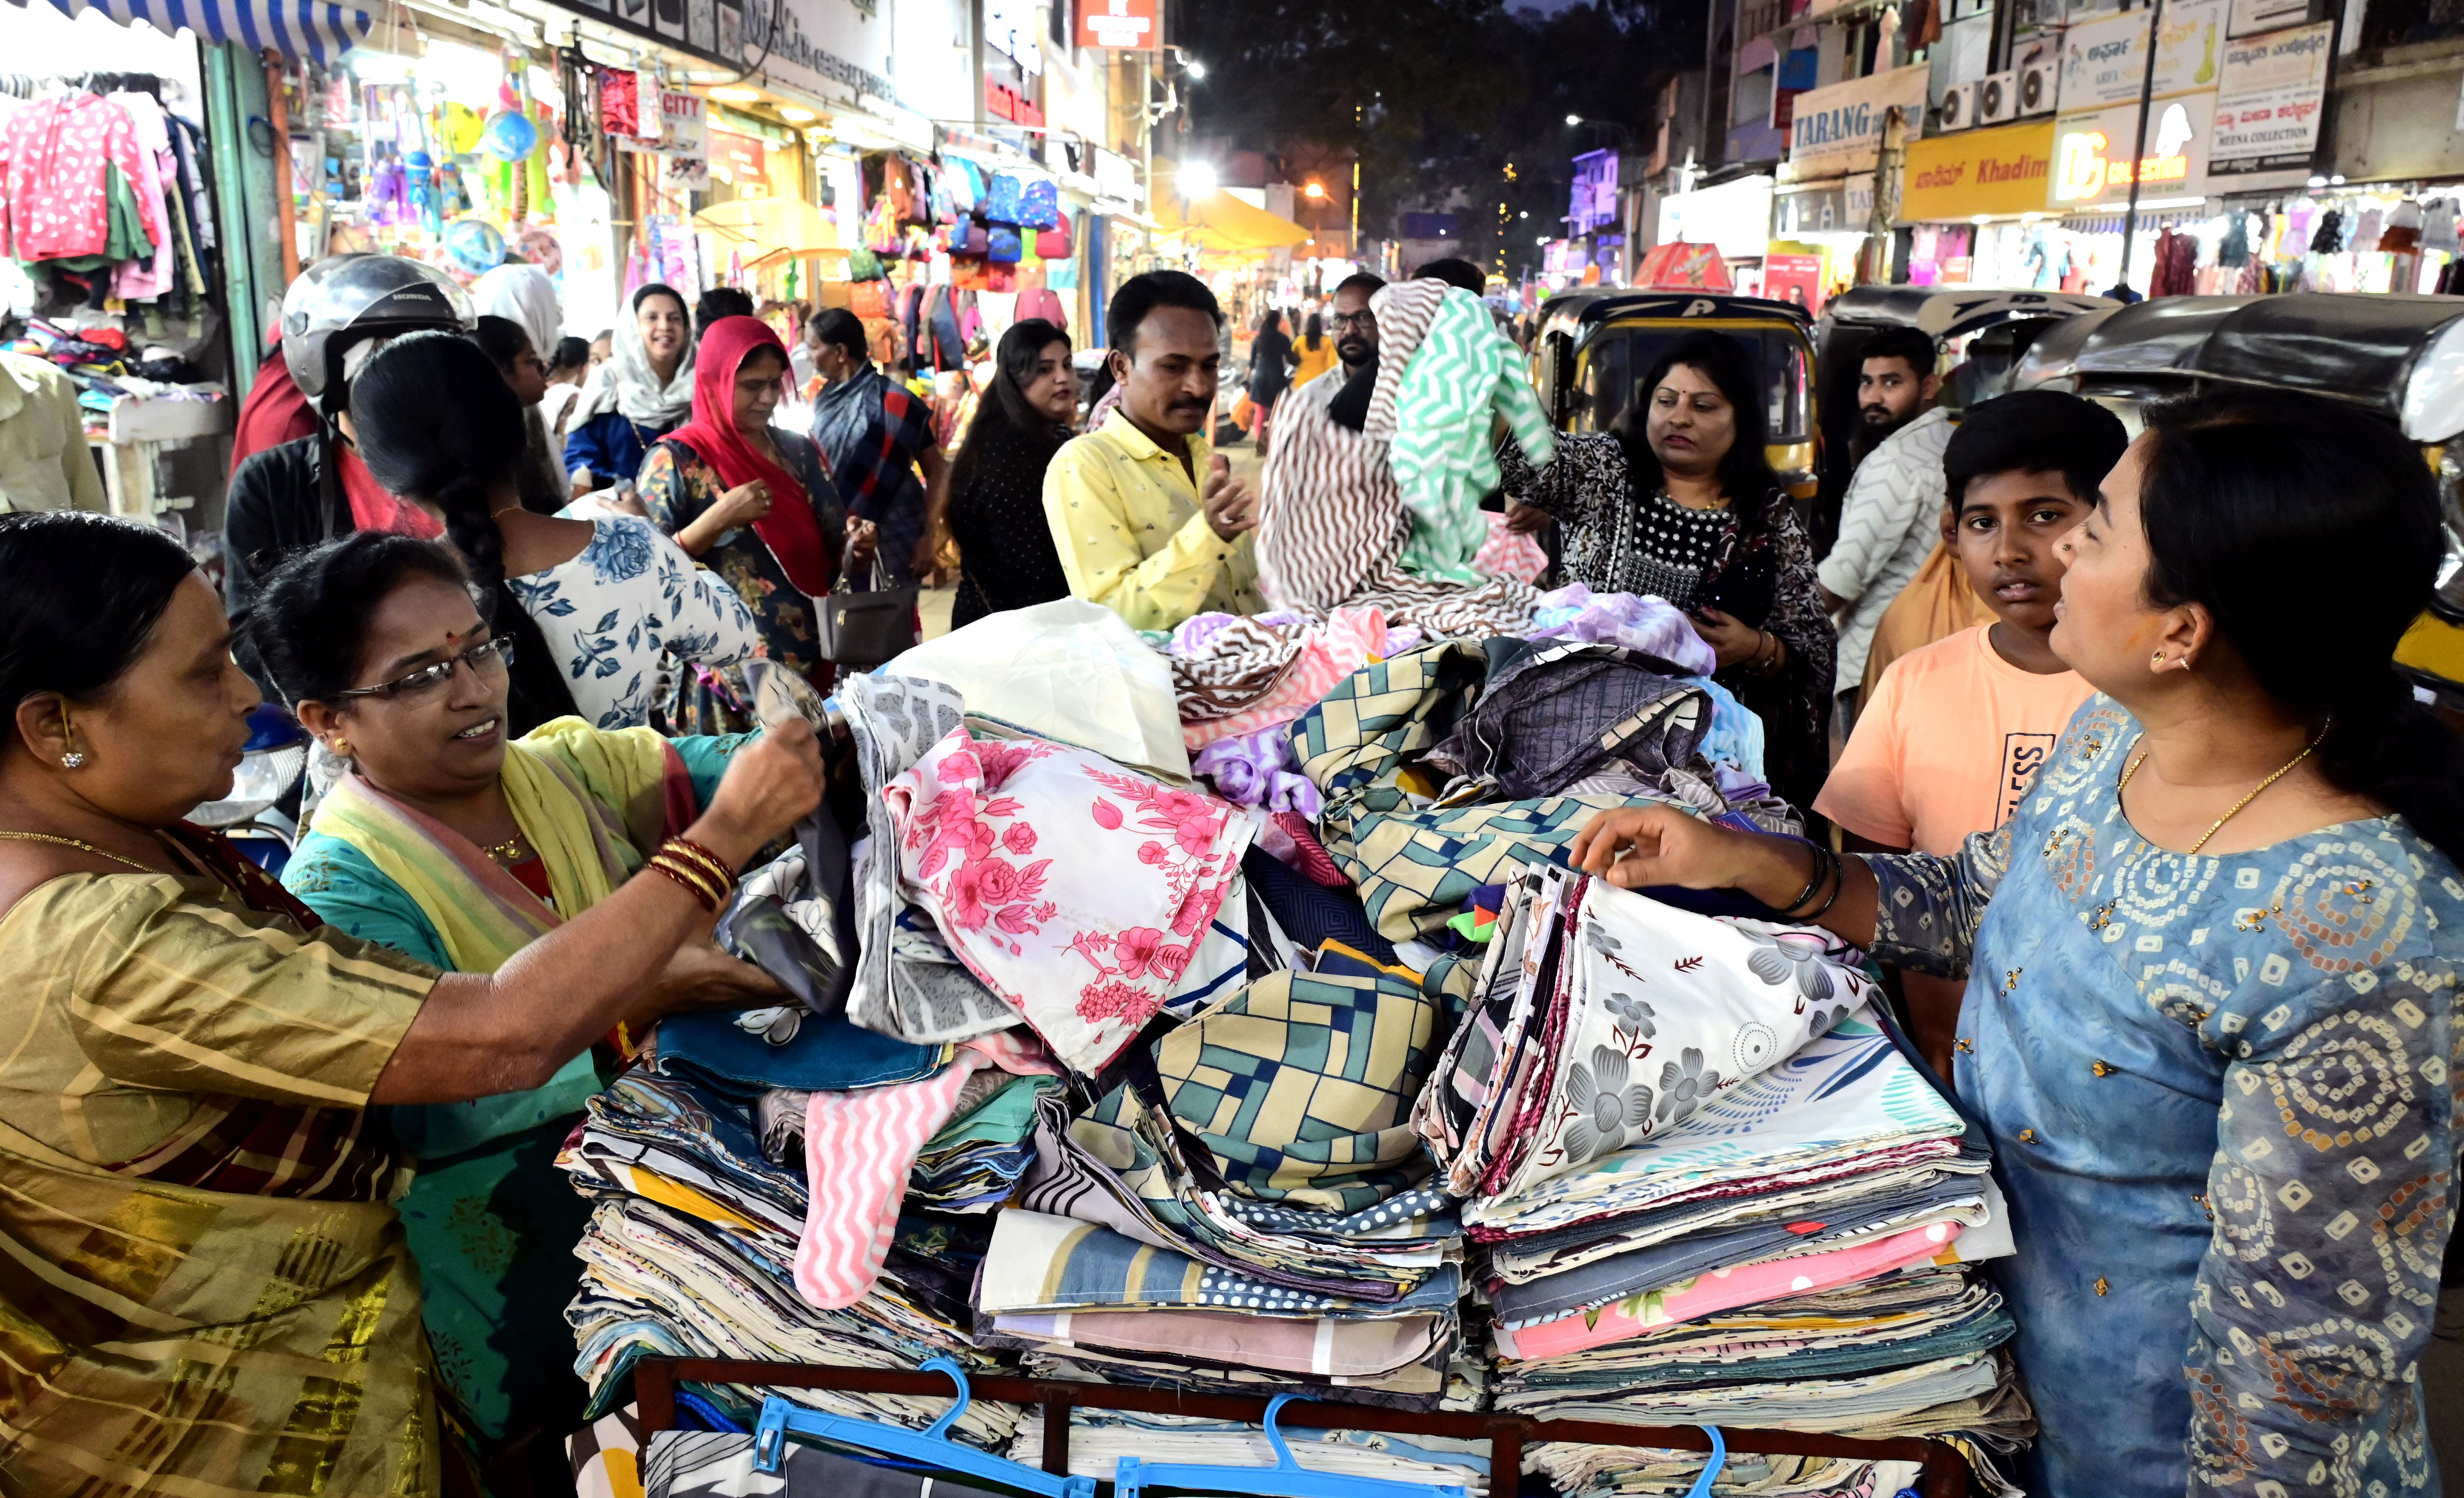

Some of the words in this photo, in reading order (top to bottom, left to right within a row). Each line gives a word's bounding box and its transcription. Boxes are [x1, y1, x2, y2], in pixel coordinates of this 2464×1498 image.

[663, 93, 699, 116] CITY
[1795, 102, 1869, 148] TARANG
[2250, 127, 2307, 143] COLLECTION
[1977, 154, 2048, 183] Khadim
